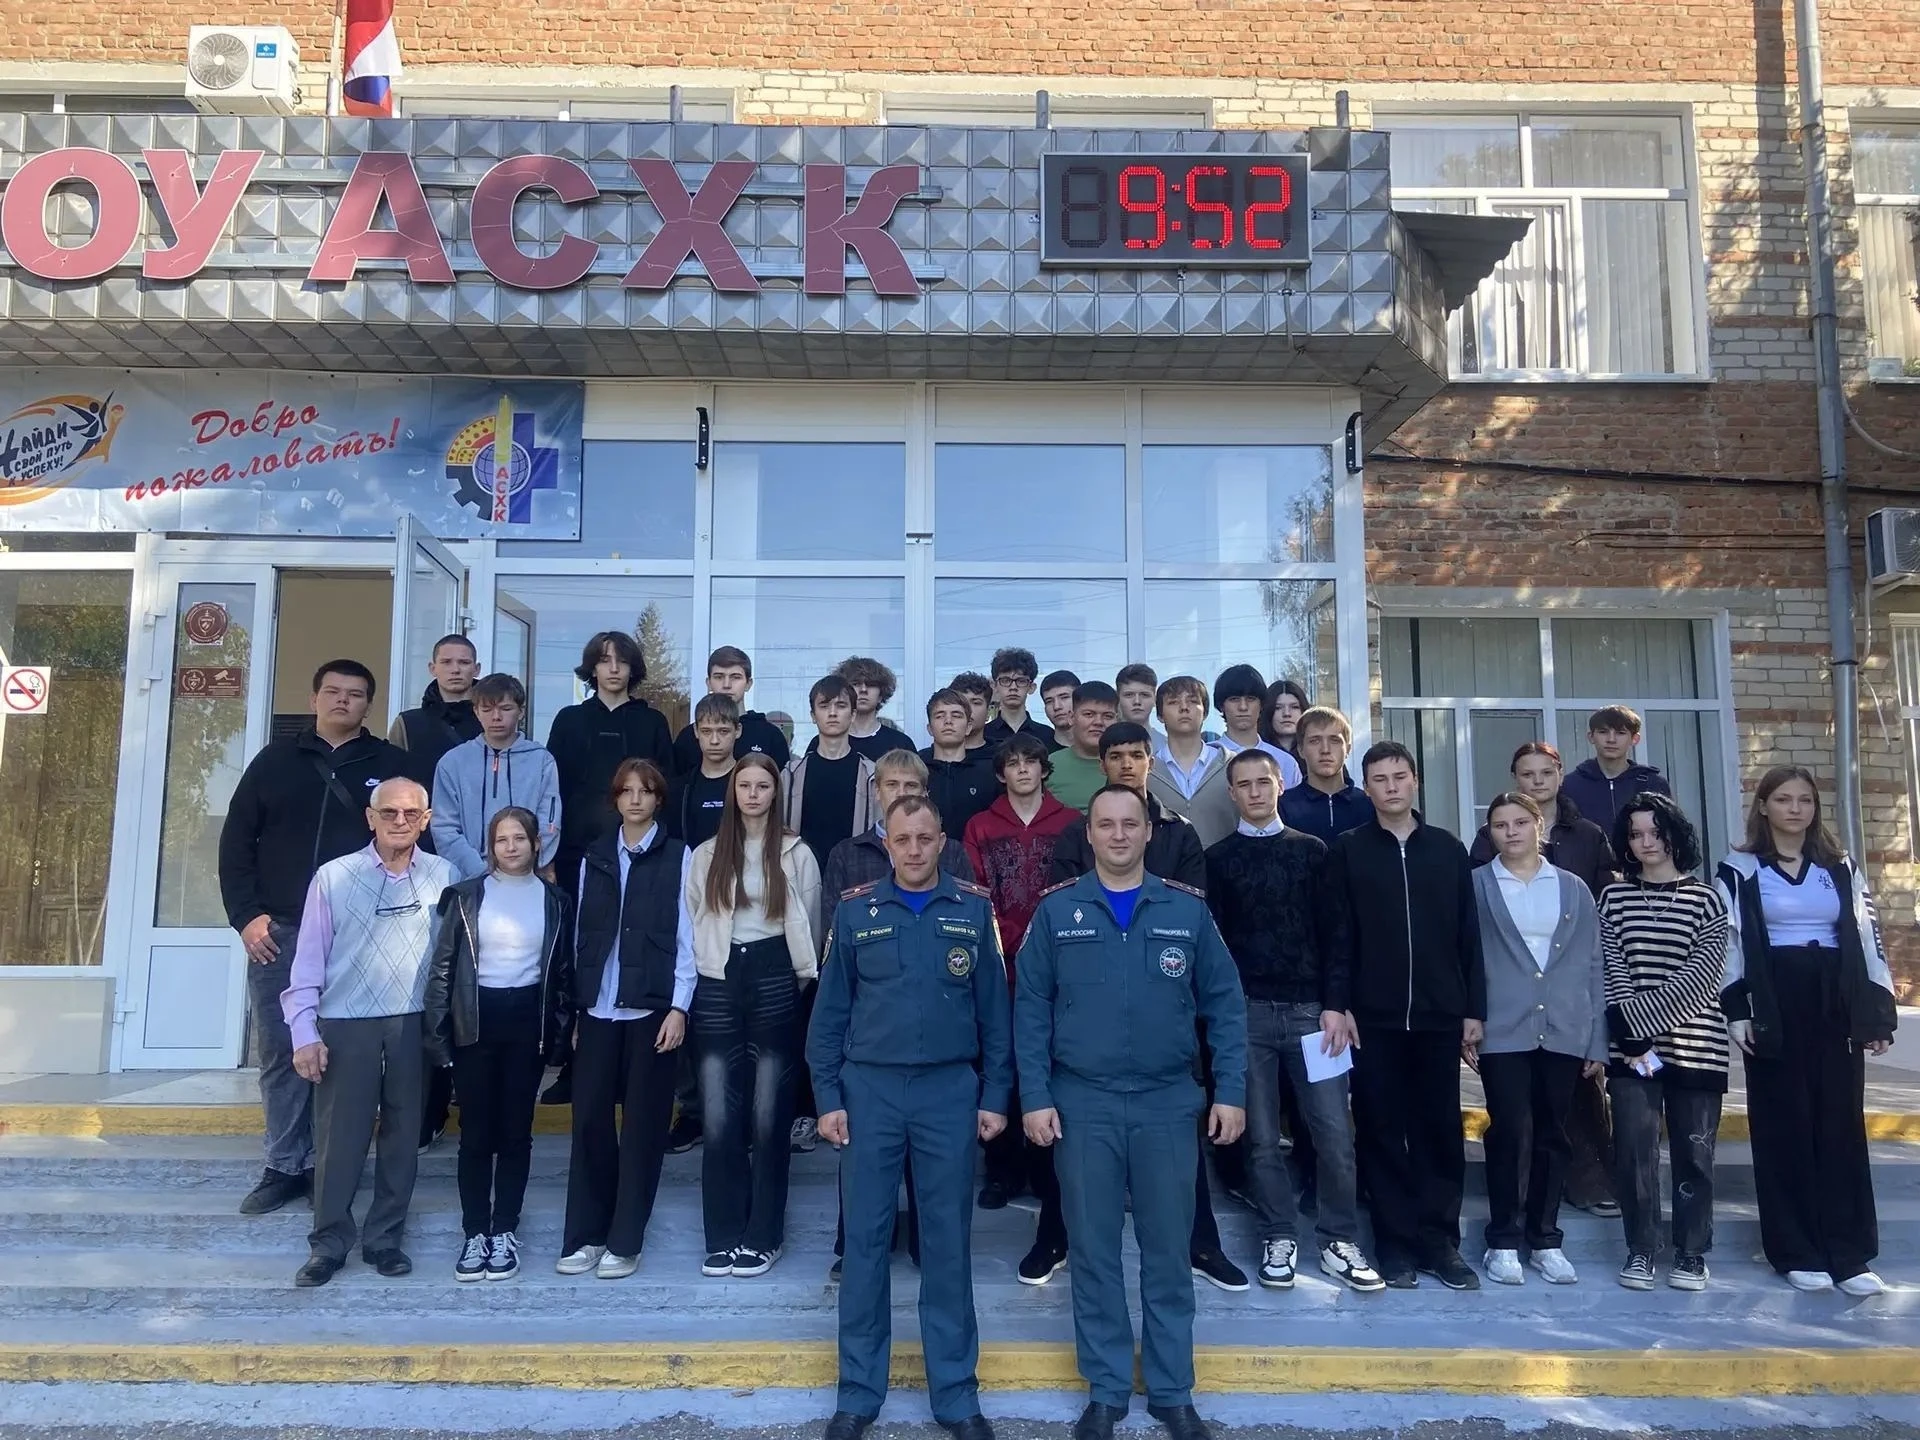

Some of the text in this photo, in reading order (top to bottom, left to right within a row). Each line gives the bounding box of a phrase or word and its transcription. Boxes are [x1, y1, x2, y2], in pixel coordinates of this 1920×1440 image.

[1, 147, 922, 295] ОУ АСХК
[1119, 165, 1291, 249] 9:52
[191, 400, 319, 444] Добро
[14, 440, 72, 472] СВОЙ ПУТЬ
[21, 455, 63, 481] УСПЕХУ!
[494, 466, 509, 522] АСХК
